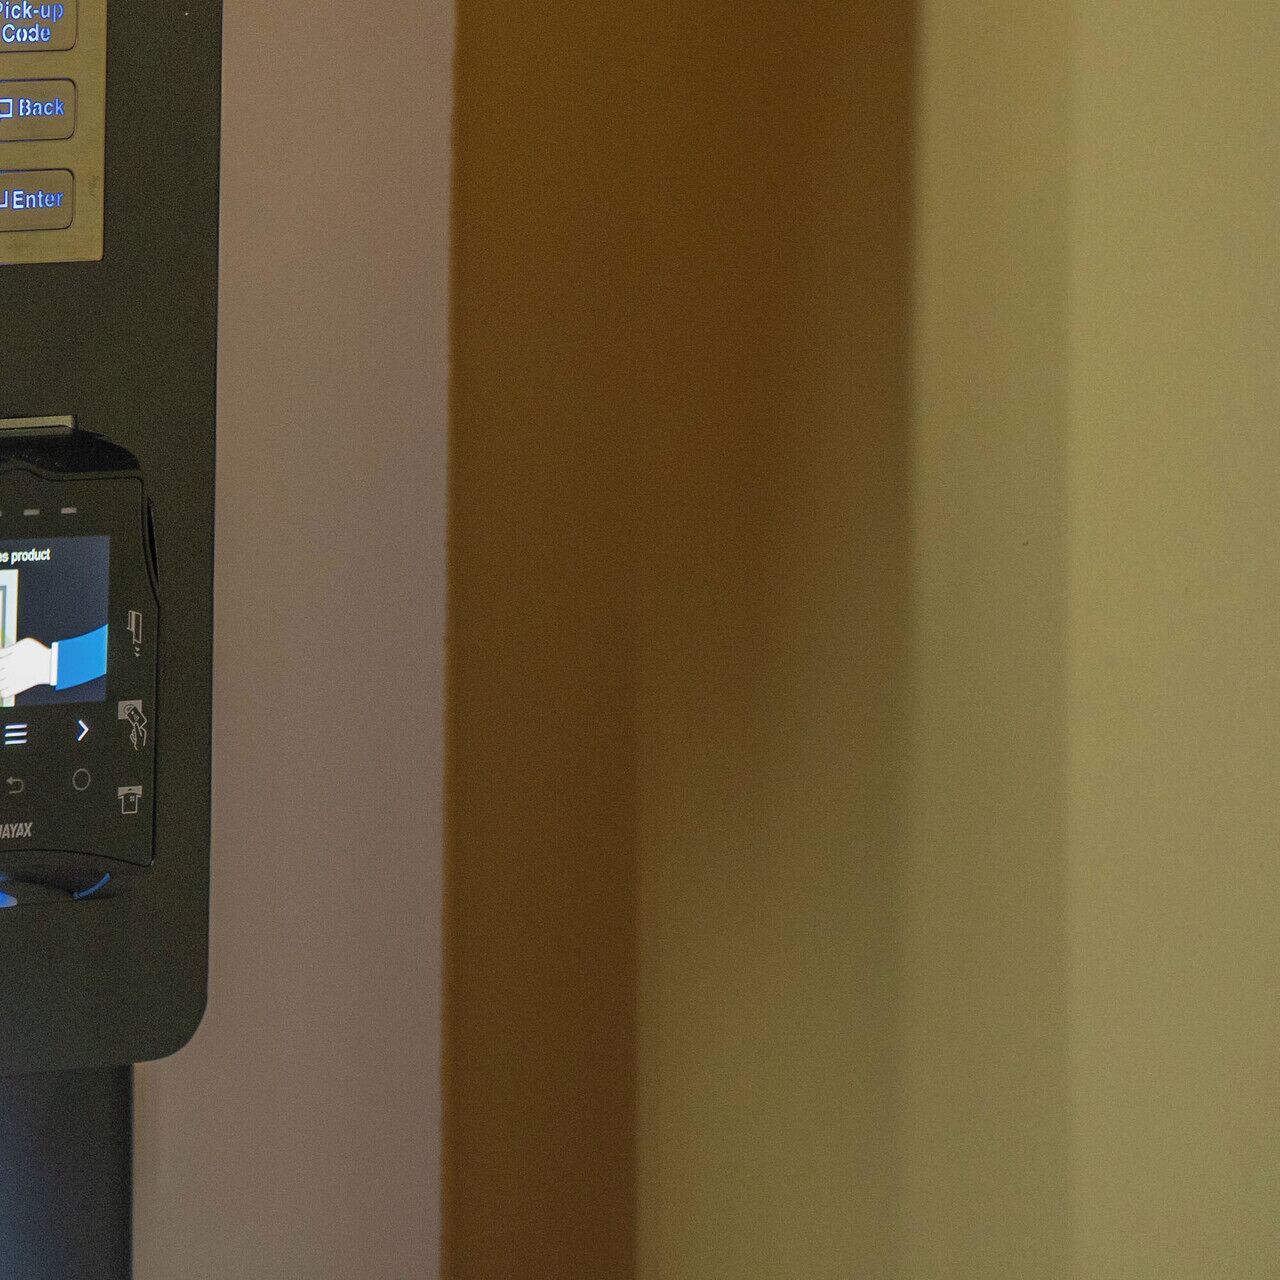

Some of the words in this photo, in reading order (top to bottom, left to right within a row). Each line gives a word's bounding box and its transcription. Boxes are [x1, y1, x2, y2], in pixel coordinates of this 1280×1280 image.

[1, 23, 51, 43] Code
[18, 97, 65, 117] Back
[12, 189, 64, 209] Enter
[10, 547, 51, 565] product
